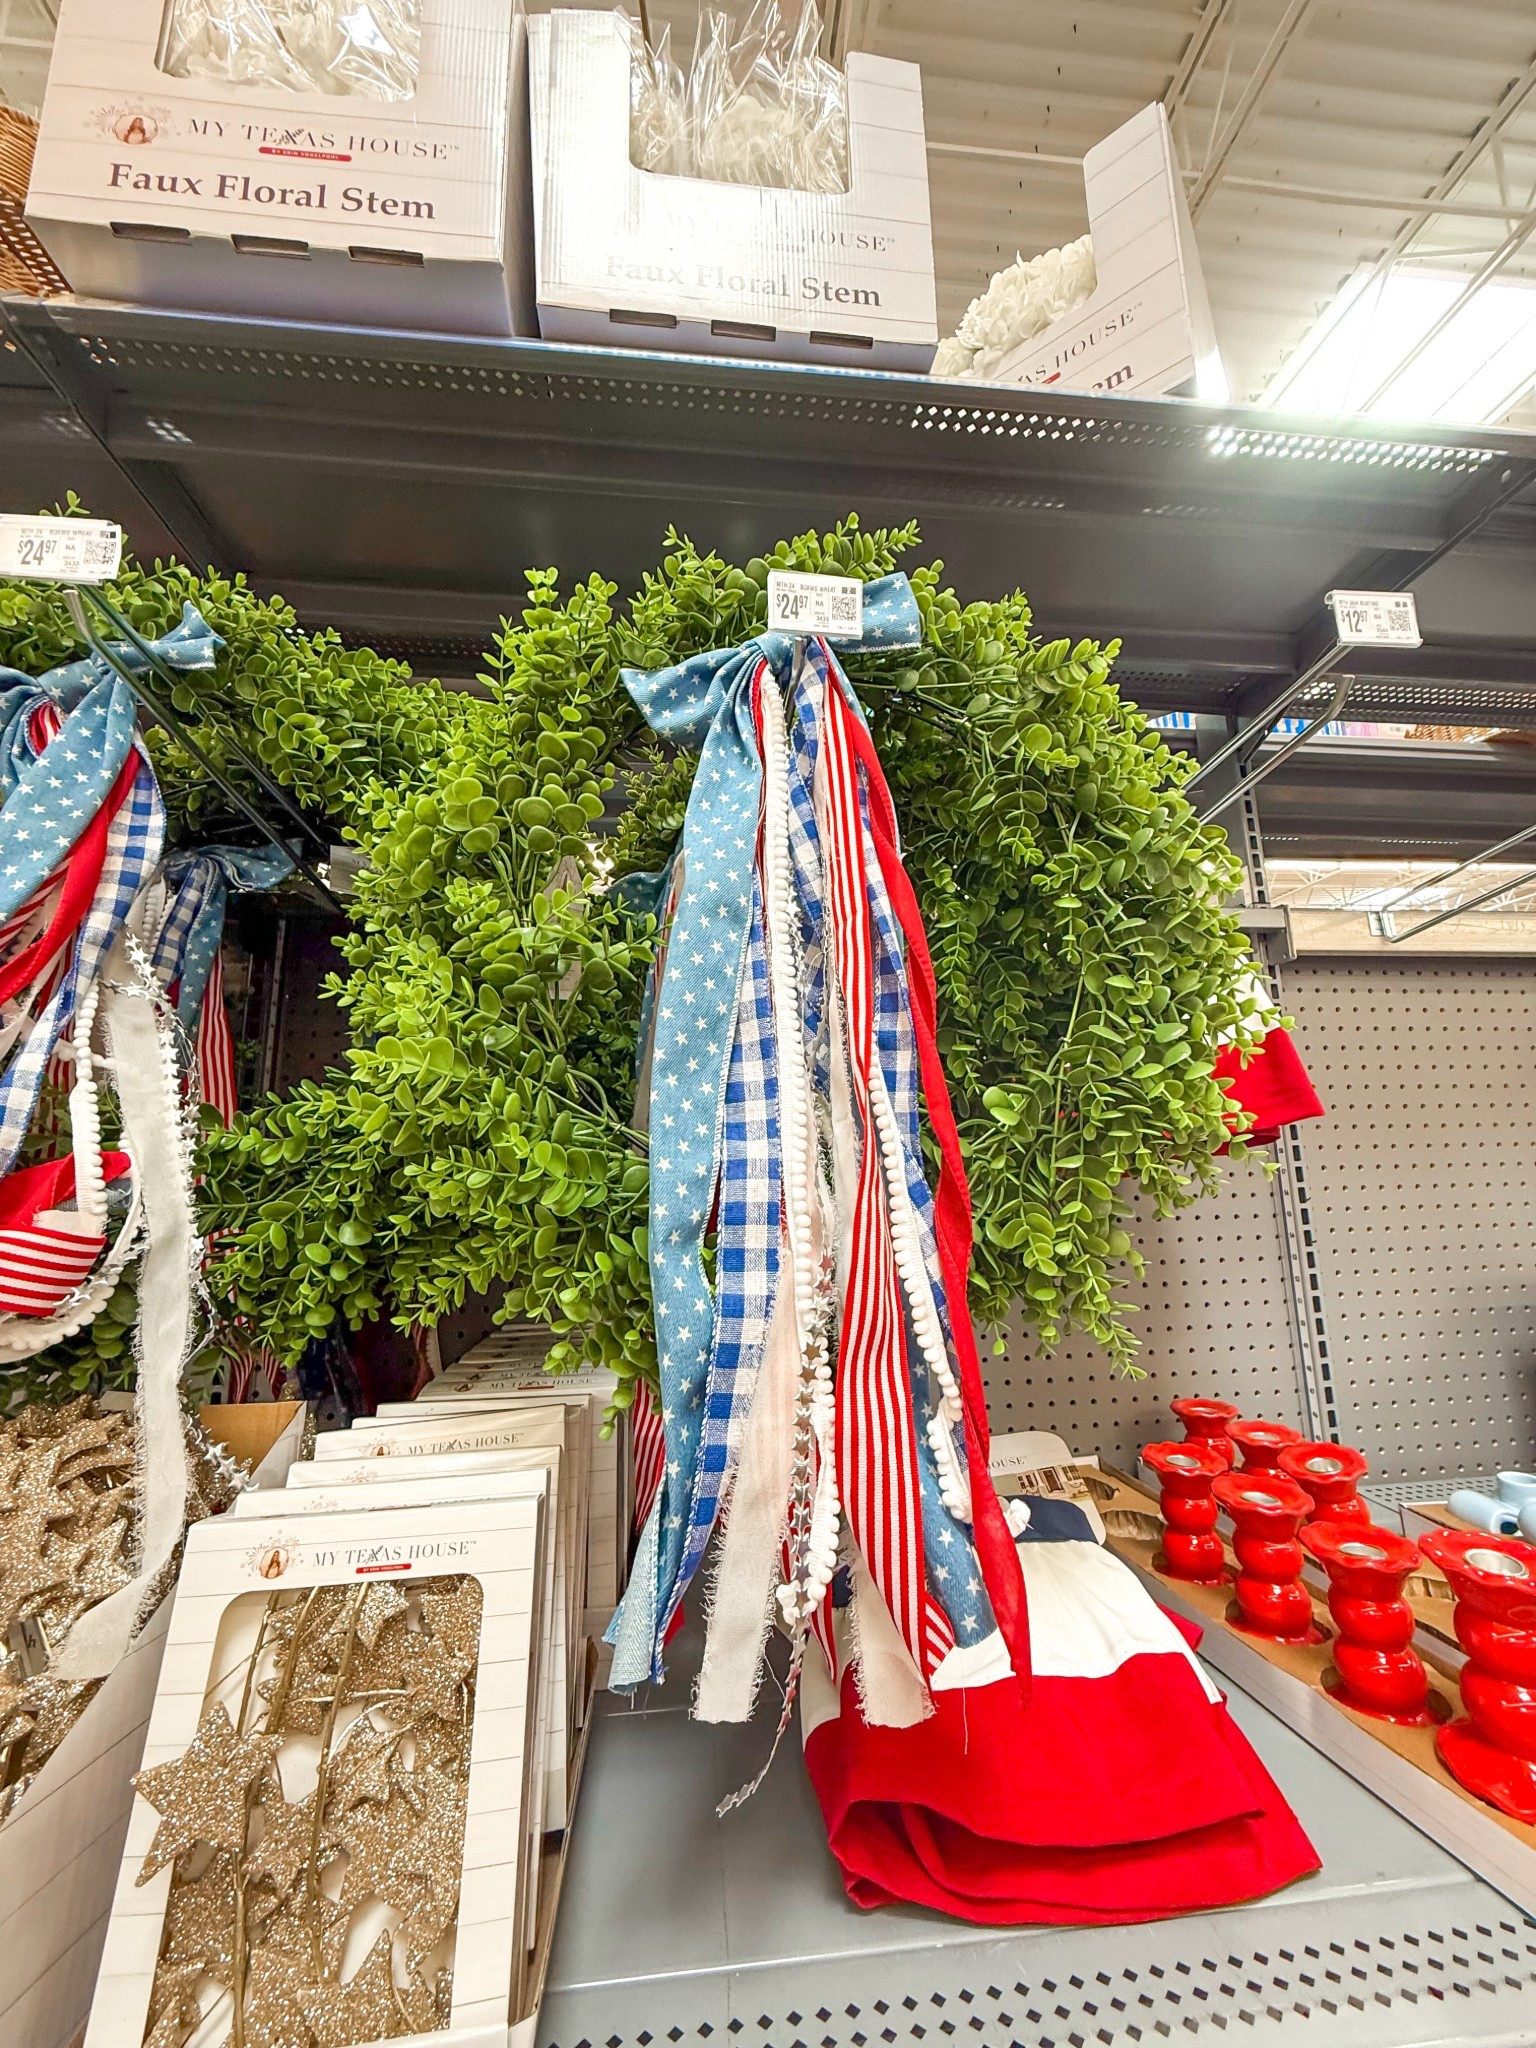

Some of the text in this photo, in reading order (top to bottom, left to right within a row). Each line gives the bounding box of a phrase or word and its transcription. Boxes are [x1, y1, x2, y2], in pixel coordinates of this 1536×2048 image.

[188, 118, 231, 138] MY
[241, 123, 335, 148] TEXAS
[107, 162, 436, 220] Faux Floral Stem
[604, 253, 883, 307] Faux Floral Stem
[408, 1443, 426, 1455] MY
[430, 1439, 471, 1454] TEXAS
[312, 1550, 340, 1567] MY
[345, 1544, 402, 1565] TEXAS
